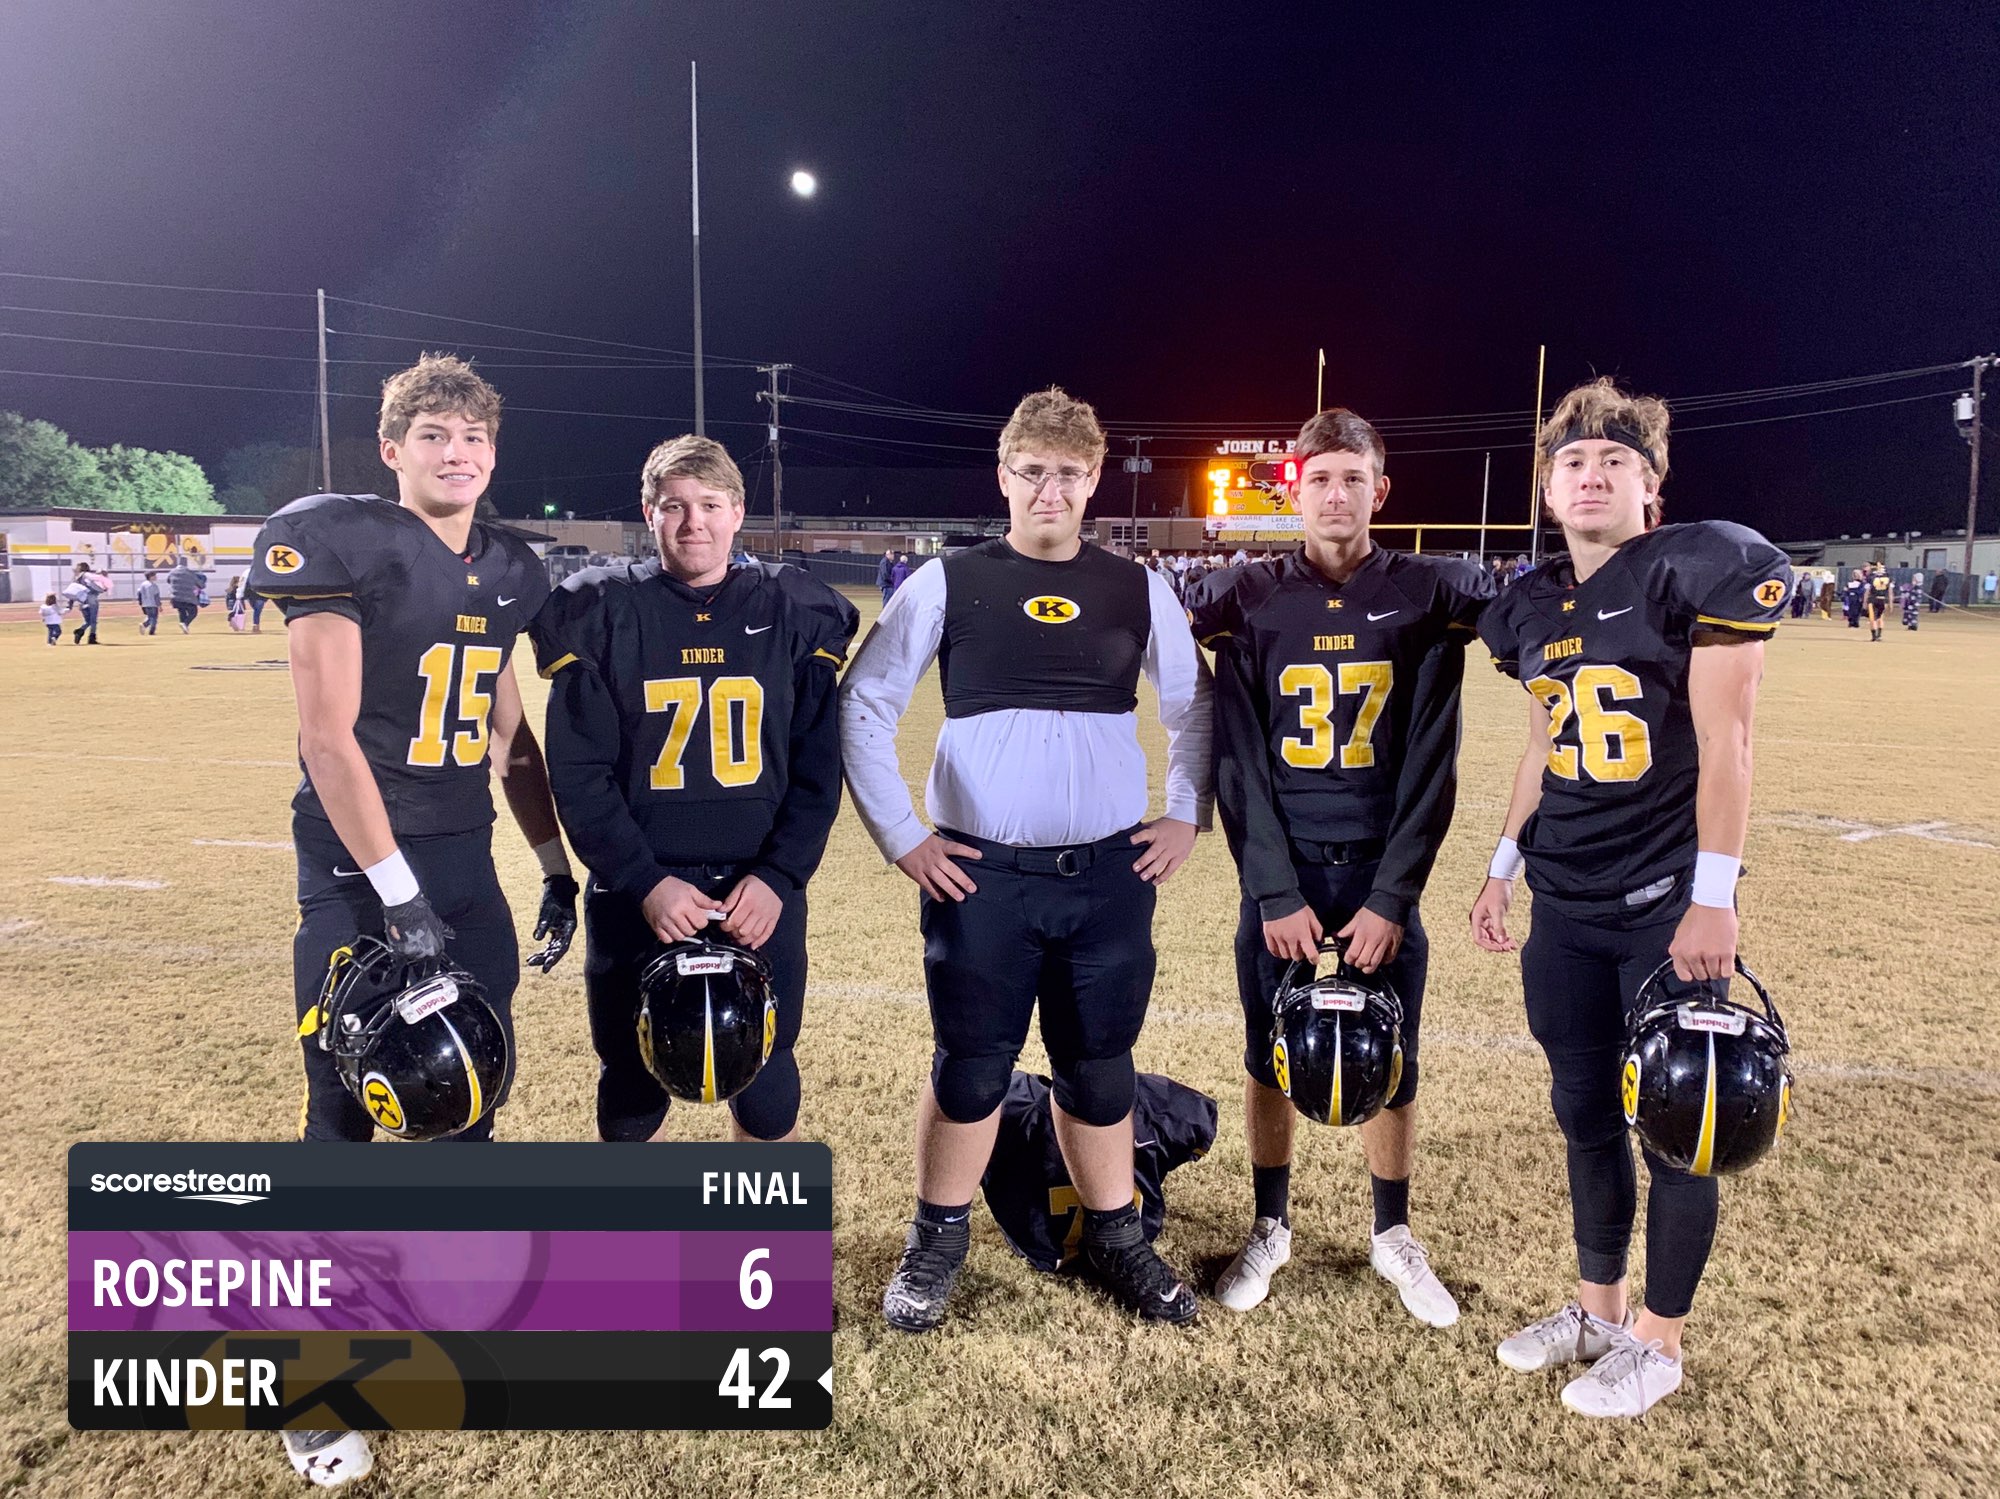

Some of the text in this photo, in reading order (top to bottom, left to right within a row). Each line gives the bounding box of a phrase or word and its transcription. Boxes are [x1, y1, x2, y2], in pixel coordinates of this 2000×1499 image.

[1216, 440, 1265, 455] JOHN
[1268, 440, 1283, 454] C.
[272, 550, 295, 568] K
[467, 575, 480, 586] K
[1761, 584, 1782, 602] K
[1035, 600, 1071, 618] K
[1327, 599, 1343, 609] K
[1562, 599, 1577, 612] K
[456, 614, 487, 634] KINDER
[696, 613, 711, 622] K
[1313, 635, 1355, 651] KINDER
[1544, 637, 1583, 661] KINDER
[681, 648, 725, 664] KINDER
[406, 642, 503, 767] 15
[1278, 660, 1394, 769] 37
[1525, 664, 1653, 783] 26
[643, 675, 765, 790] 70
[688, 962, 721, 972] Riddell
[415, 995, 448, 1016] Riddell
[1322, 999, 1353, 1007] Riddell
[1692, 1018, 1730, 1030] Riddell
[368, 1089, 399, 1125] K
